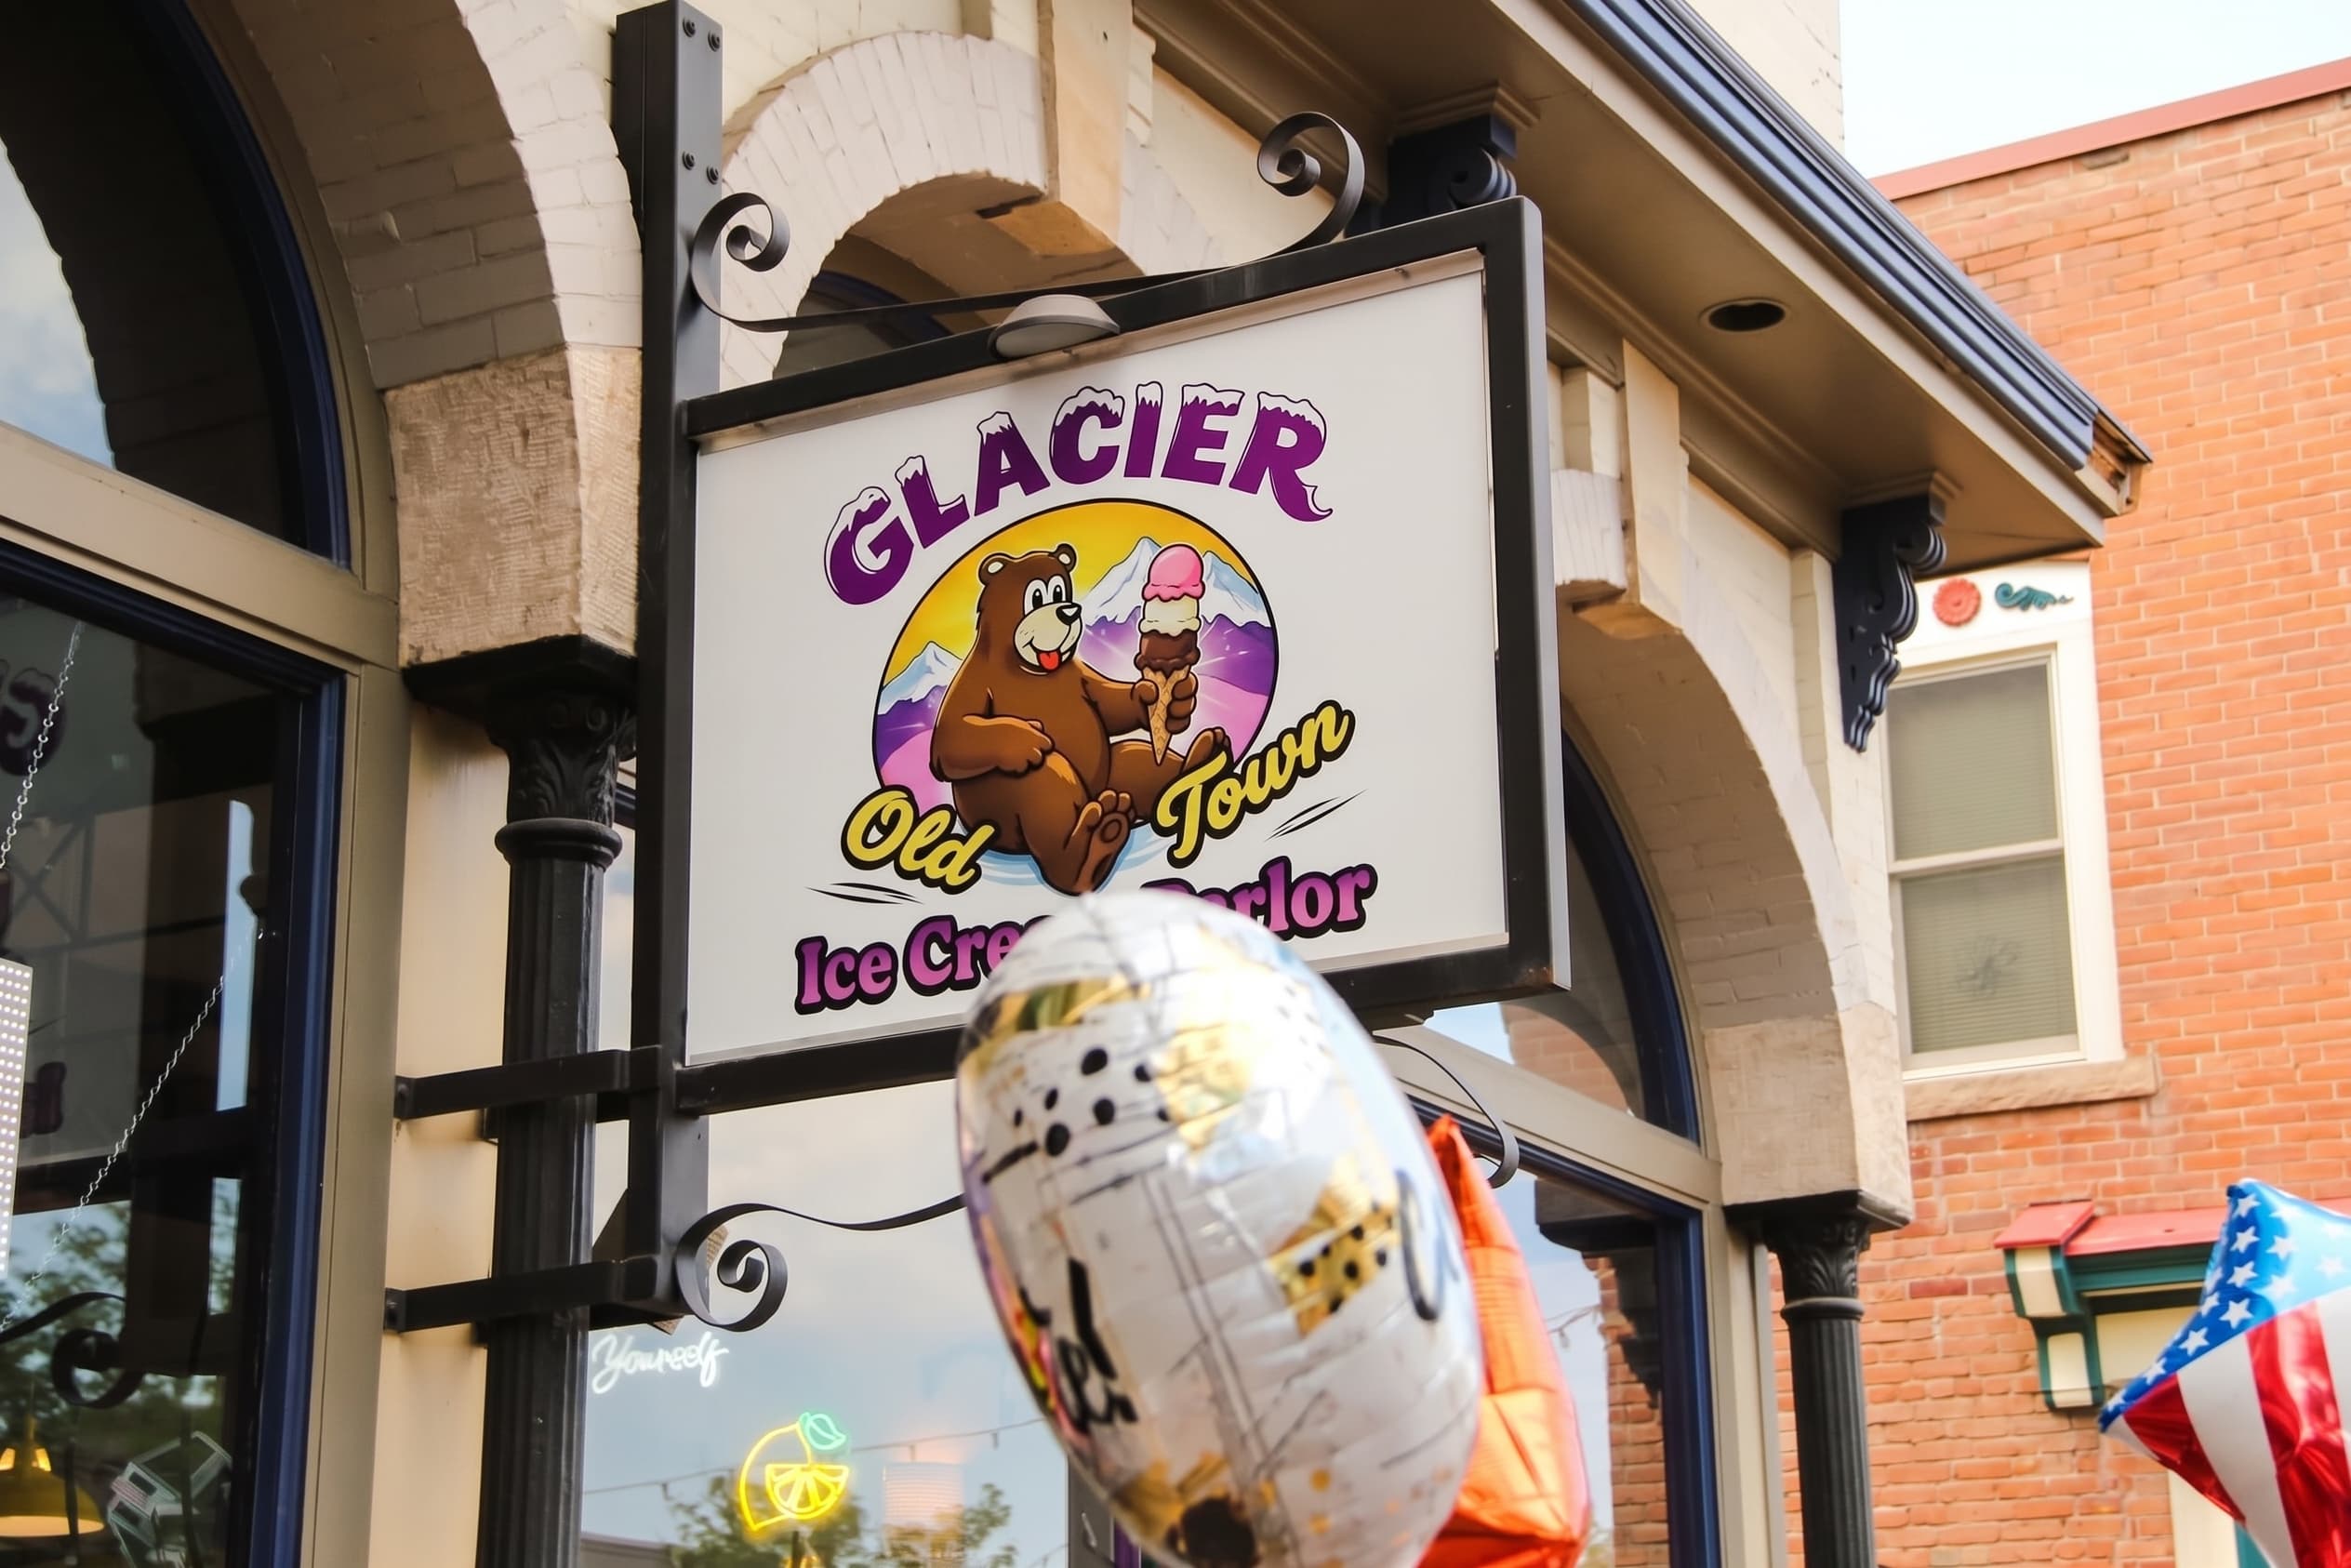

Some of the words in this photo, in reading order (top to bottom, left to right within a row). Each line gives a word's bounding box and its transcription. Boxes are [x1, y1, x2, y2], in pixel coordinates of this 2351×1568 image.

[824, 381, 1333, 605] GLACIER
[841, 786, 999, 895] Old
[1149, 699, 1356, 869] Town
[794, 936, 898, 1015] Ice
[903, 915, 1055, 997] Cre
[1140, 856, 1378, 941] rlor
[591, 1331, 730, 1394] Yourself
